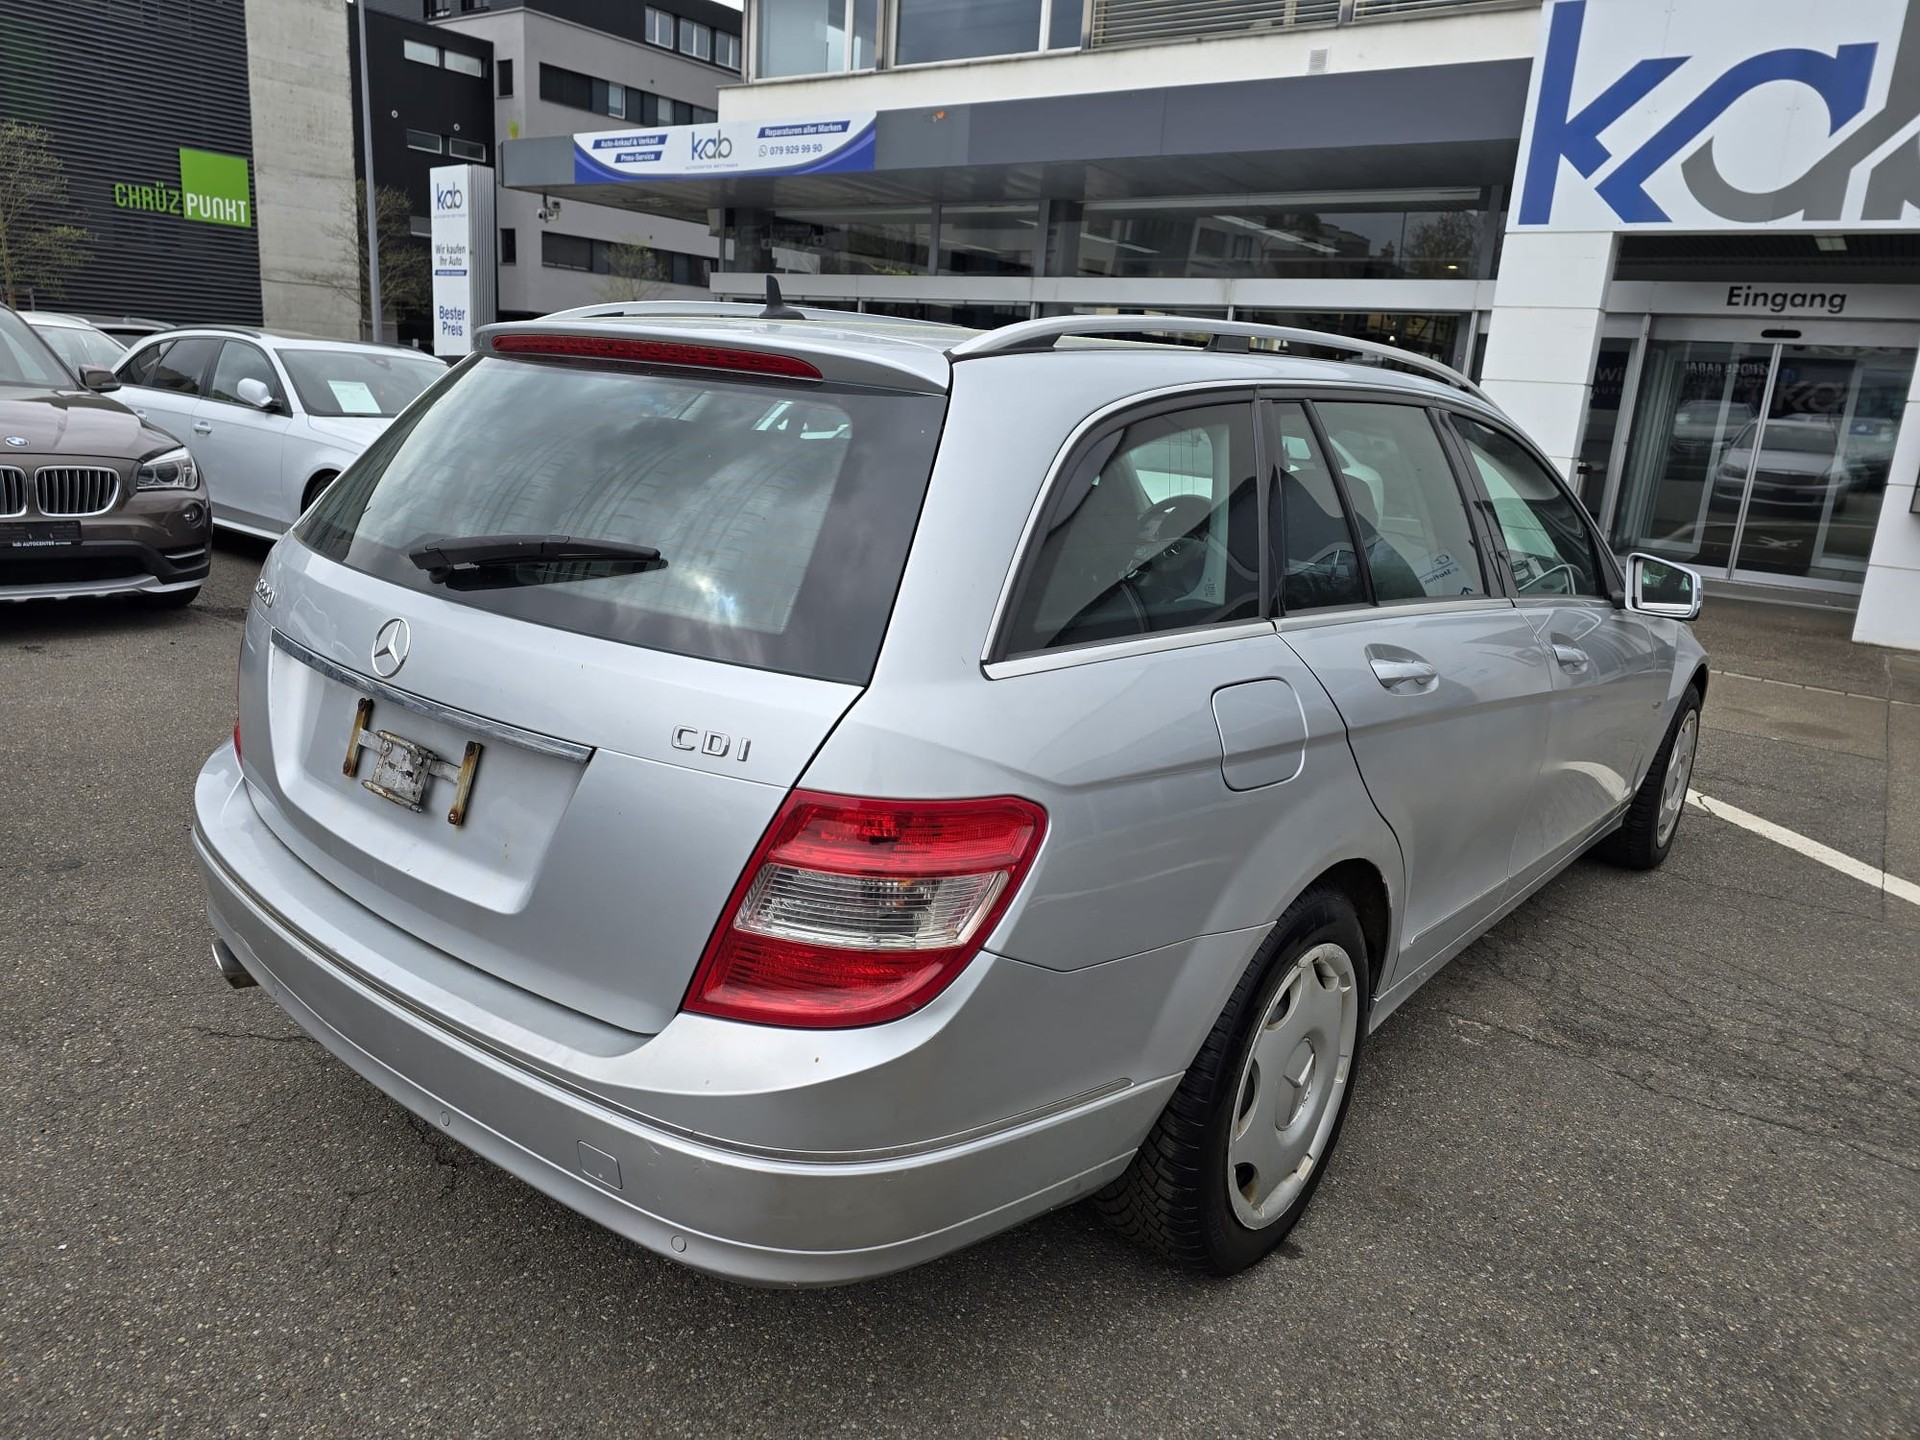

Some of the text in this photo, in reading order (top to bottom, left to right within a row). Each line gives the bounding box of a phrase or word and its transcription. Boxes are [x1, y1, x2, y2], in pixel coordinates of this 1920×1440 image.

[765, 124, 843, 137] Reparaturen aller Marken
[601, 138, 632, 147] Auto-Ankauf
[638, 136, 659, 145] Verkauf
[691, 129, 733, 161] kab
[769, 143, 823, 156] 079 929 99 90
[620, 153, 655, 162] Pneu-Service
[114, 181, 247, 224] CHRÜZ PUNKT
[436, 181, 463, 210] kab
[435, 243, 466, 255] Wir kaufen
[439, 256, 462, 266] Ihr Auto
[1726, 285, 1847, 314] Eingang
[439, 305, 466, 321] Bester
[442, 321, 463, 337] Preis
[671, 724, 752, 762] CDI
